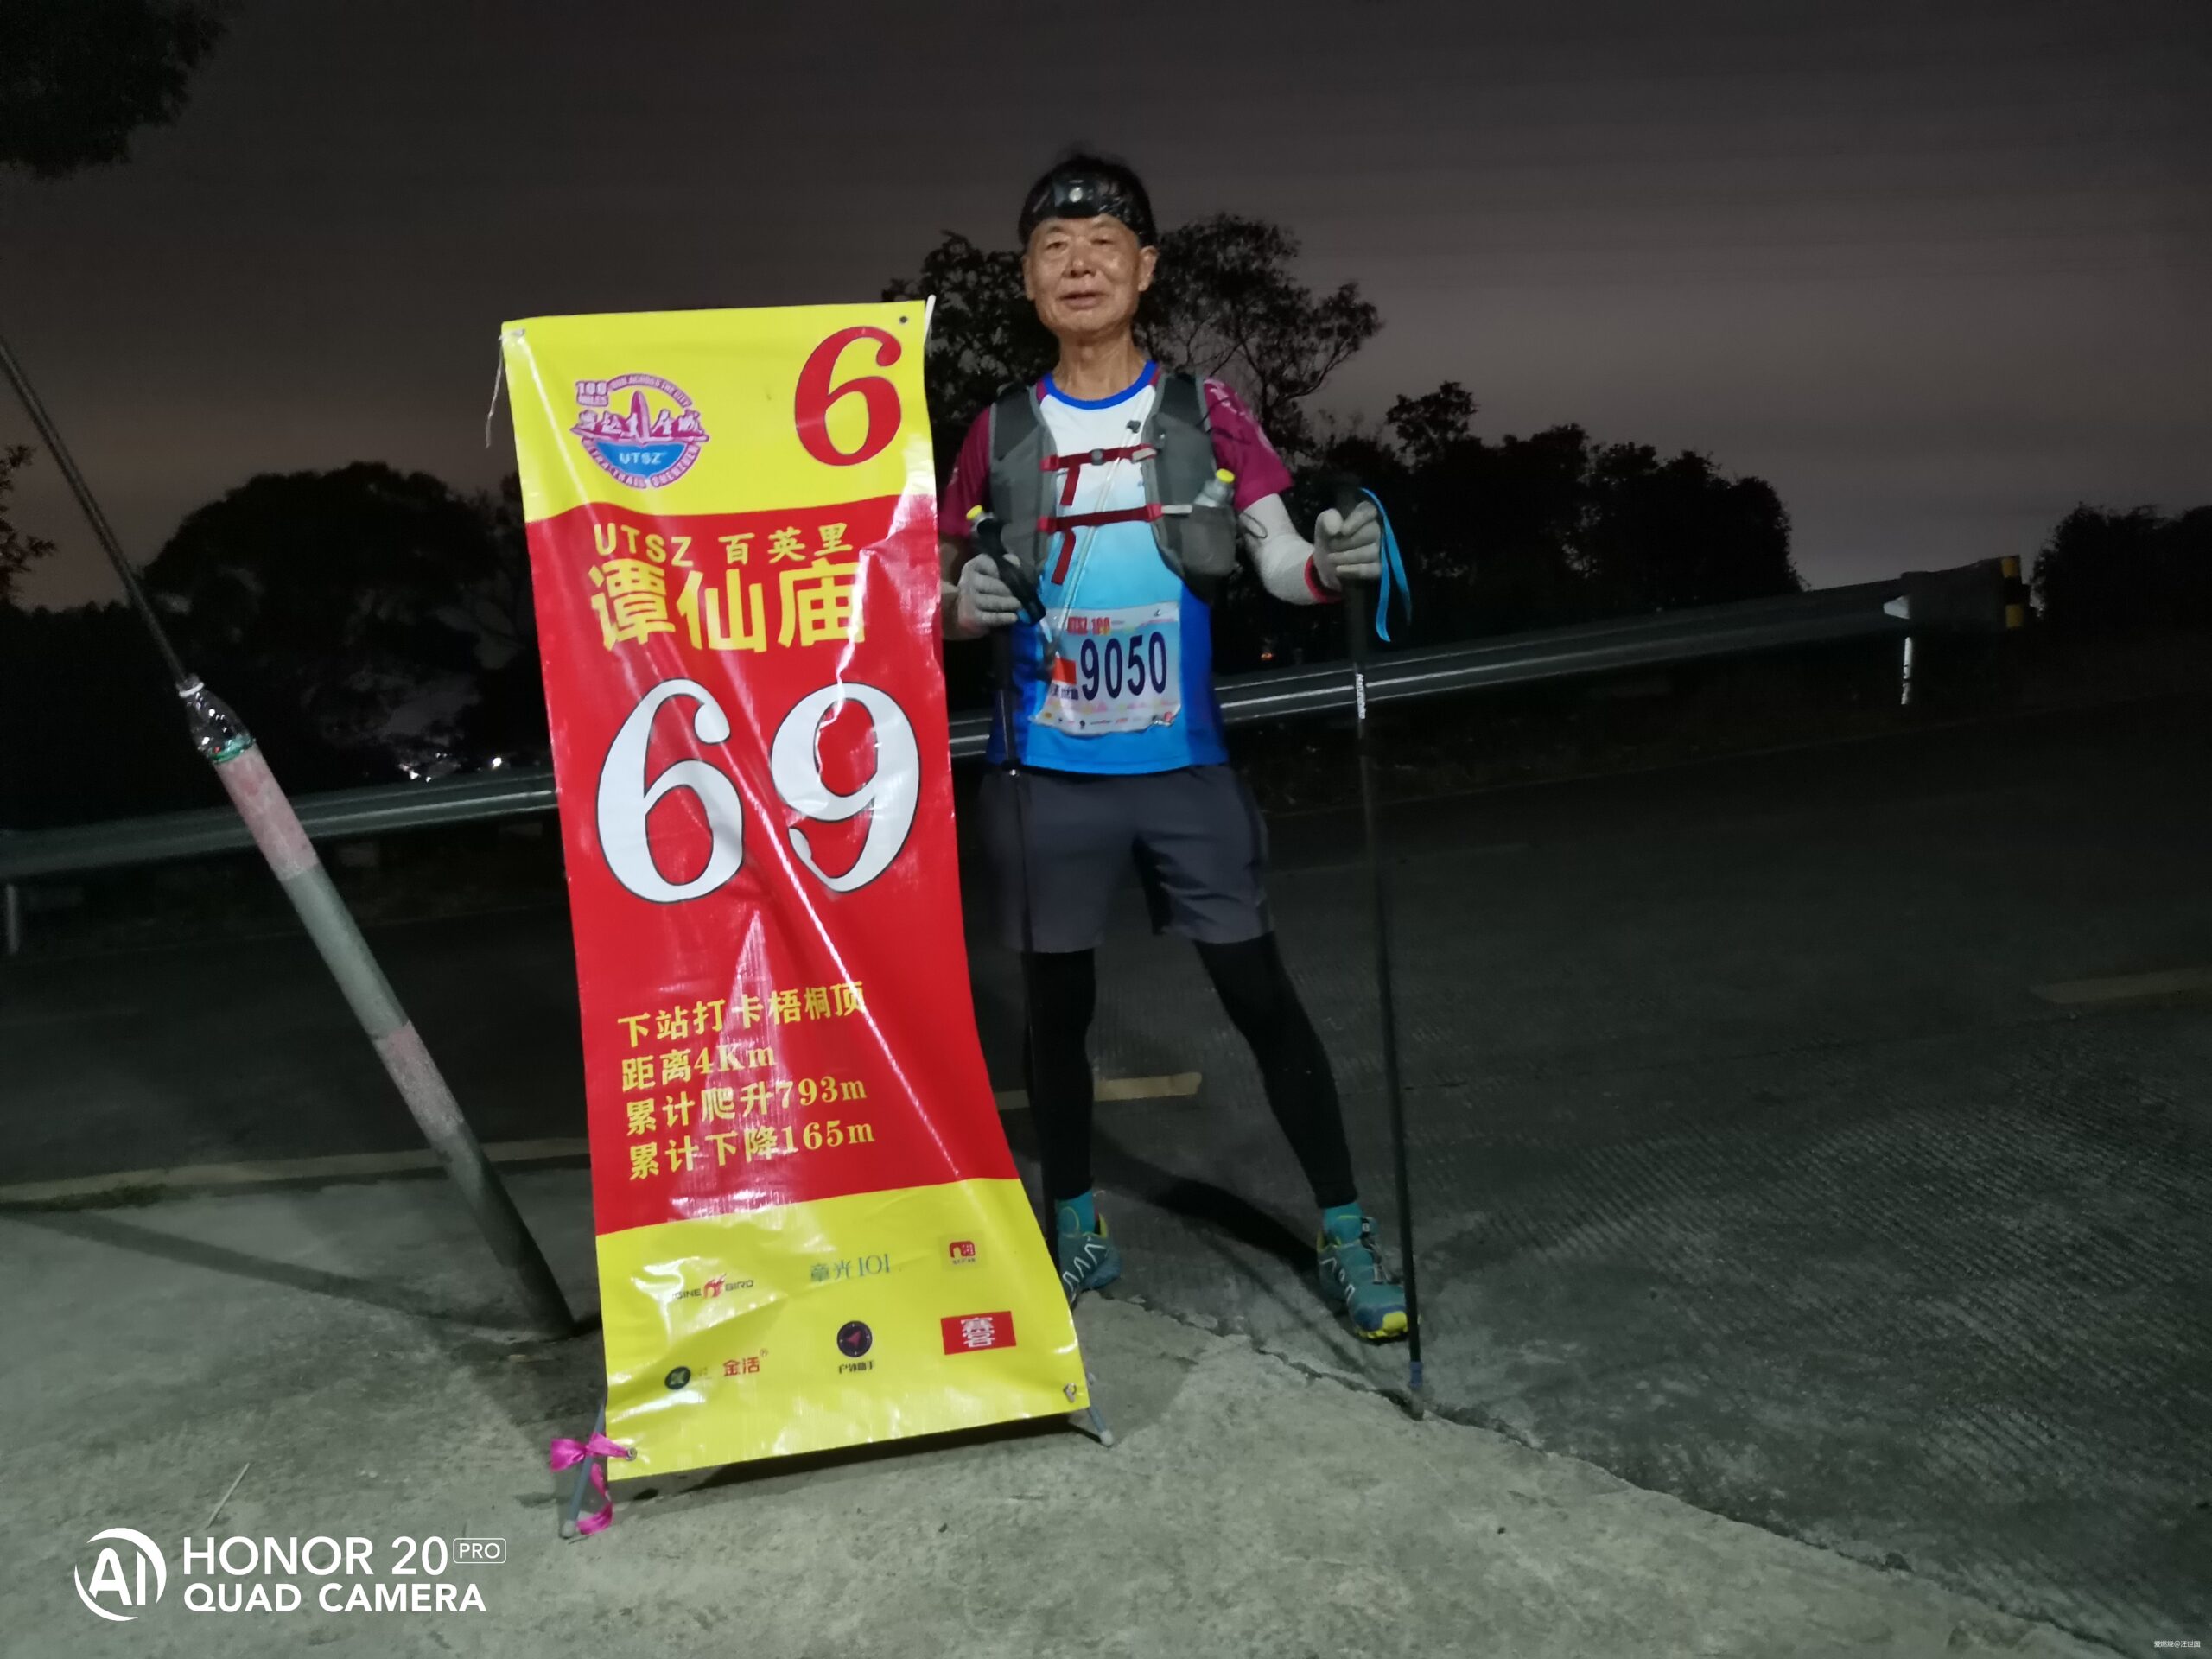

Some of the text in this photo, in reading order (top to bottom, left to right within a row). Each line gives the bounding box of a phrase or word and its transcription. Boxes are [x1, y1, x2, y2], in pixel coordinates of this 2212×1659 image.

[795, 326, 902, 467] 6
[619, 451, 666, 465] UTSZ
[594, 522, 853, 567] UTSZ 百英里
[588, 559, 866, 653] 谭仙庙
[1080, 632, 1167, 701] 9050
[596, 677, 921, 904] 69
[617, 981, 864, 1048] 下站打卡梧桐顶
[626, 1076, 868, 1136] 累计爬升793m
[629, 1119, 875, 1181] 累计下降165m
[725, 1279, 754, 1292] BIRD
